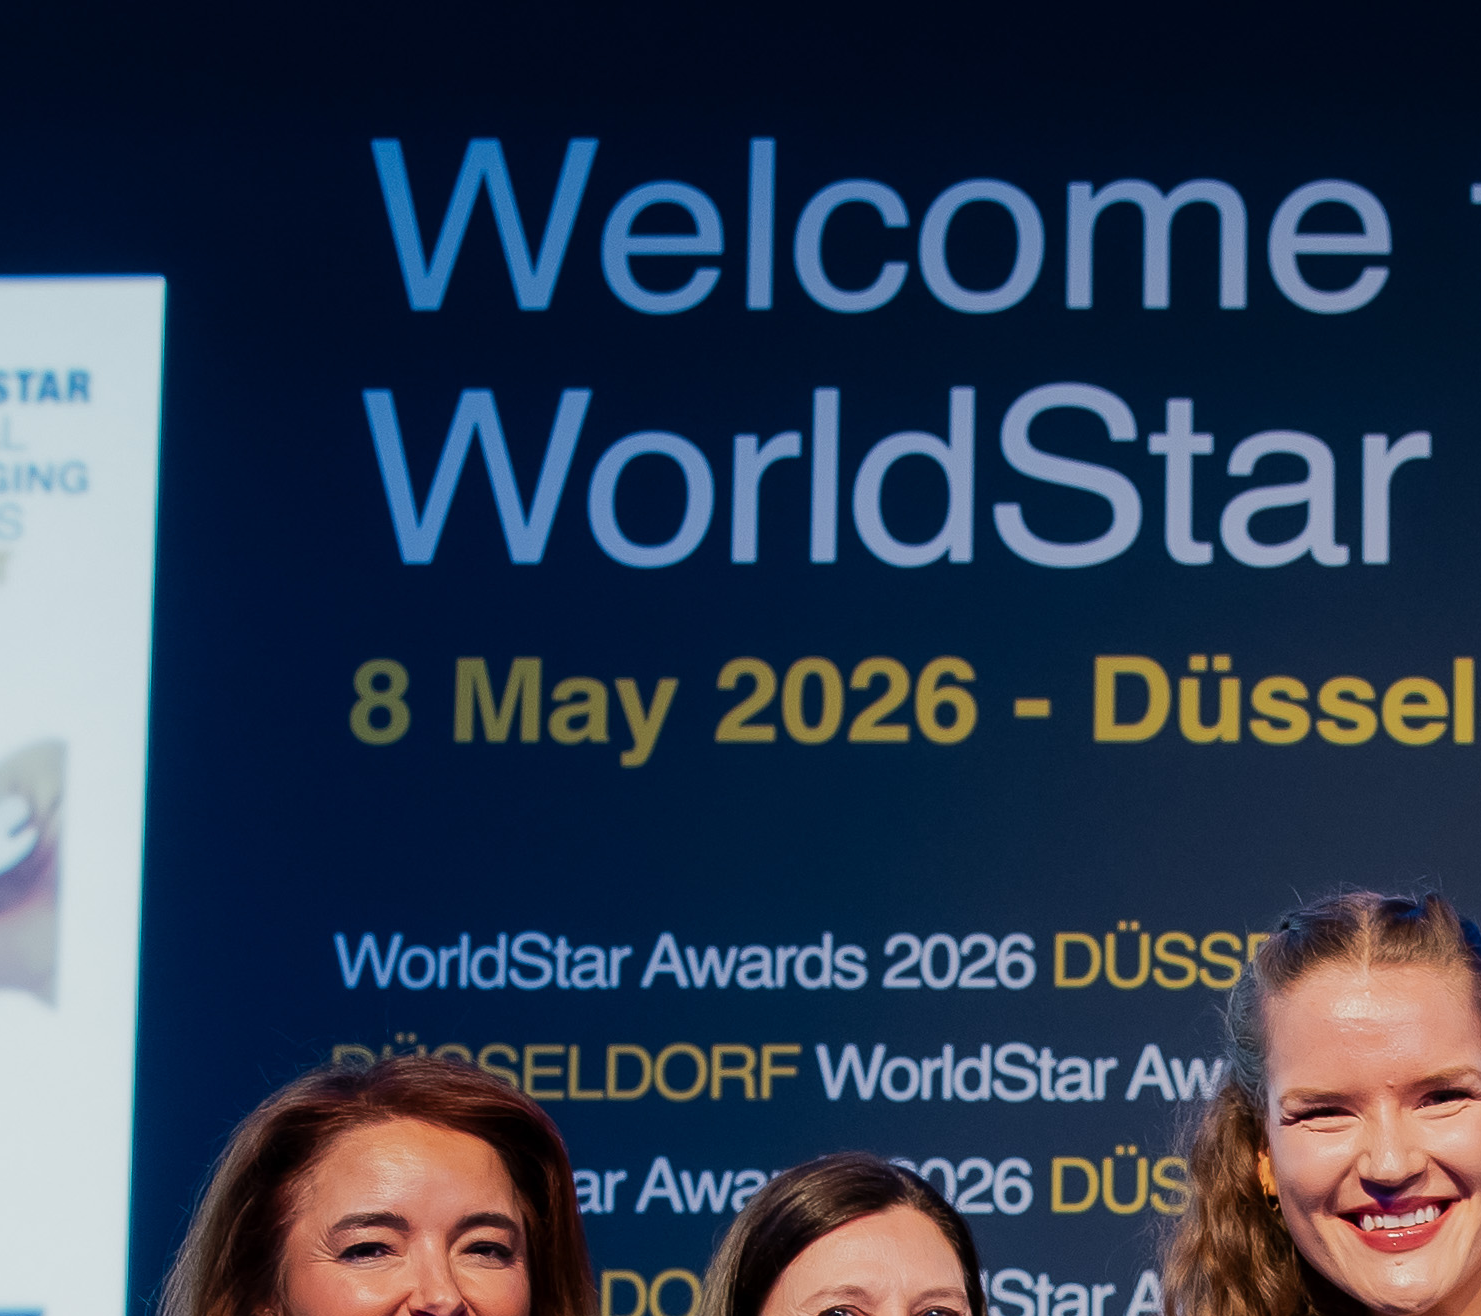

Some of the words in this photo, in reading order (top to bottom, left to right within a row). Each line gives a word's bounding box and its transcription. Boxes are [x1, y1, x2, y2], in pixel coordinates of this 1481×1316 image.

[372, 138, 1392, 314] Welcome
[364, 383, 1431, 568] WorldStar
[350, 659, 410, 744] 8
[455, 658, 678, 767] May
[716, 657, 977, 744] 2026
[1015, 699, 1050, 717] -
[335, 932, 632, 989] WorldStar
[641, 932, 868, 989] Awards
[883, 933, 1036, 989] 2026
[816, 1043, 1118, 1102] WorldStar
